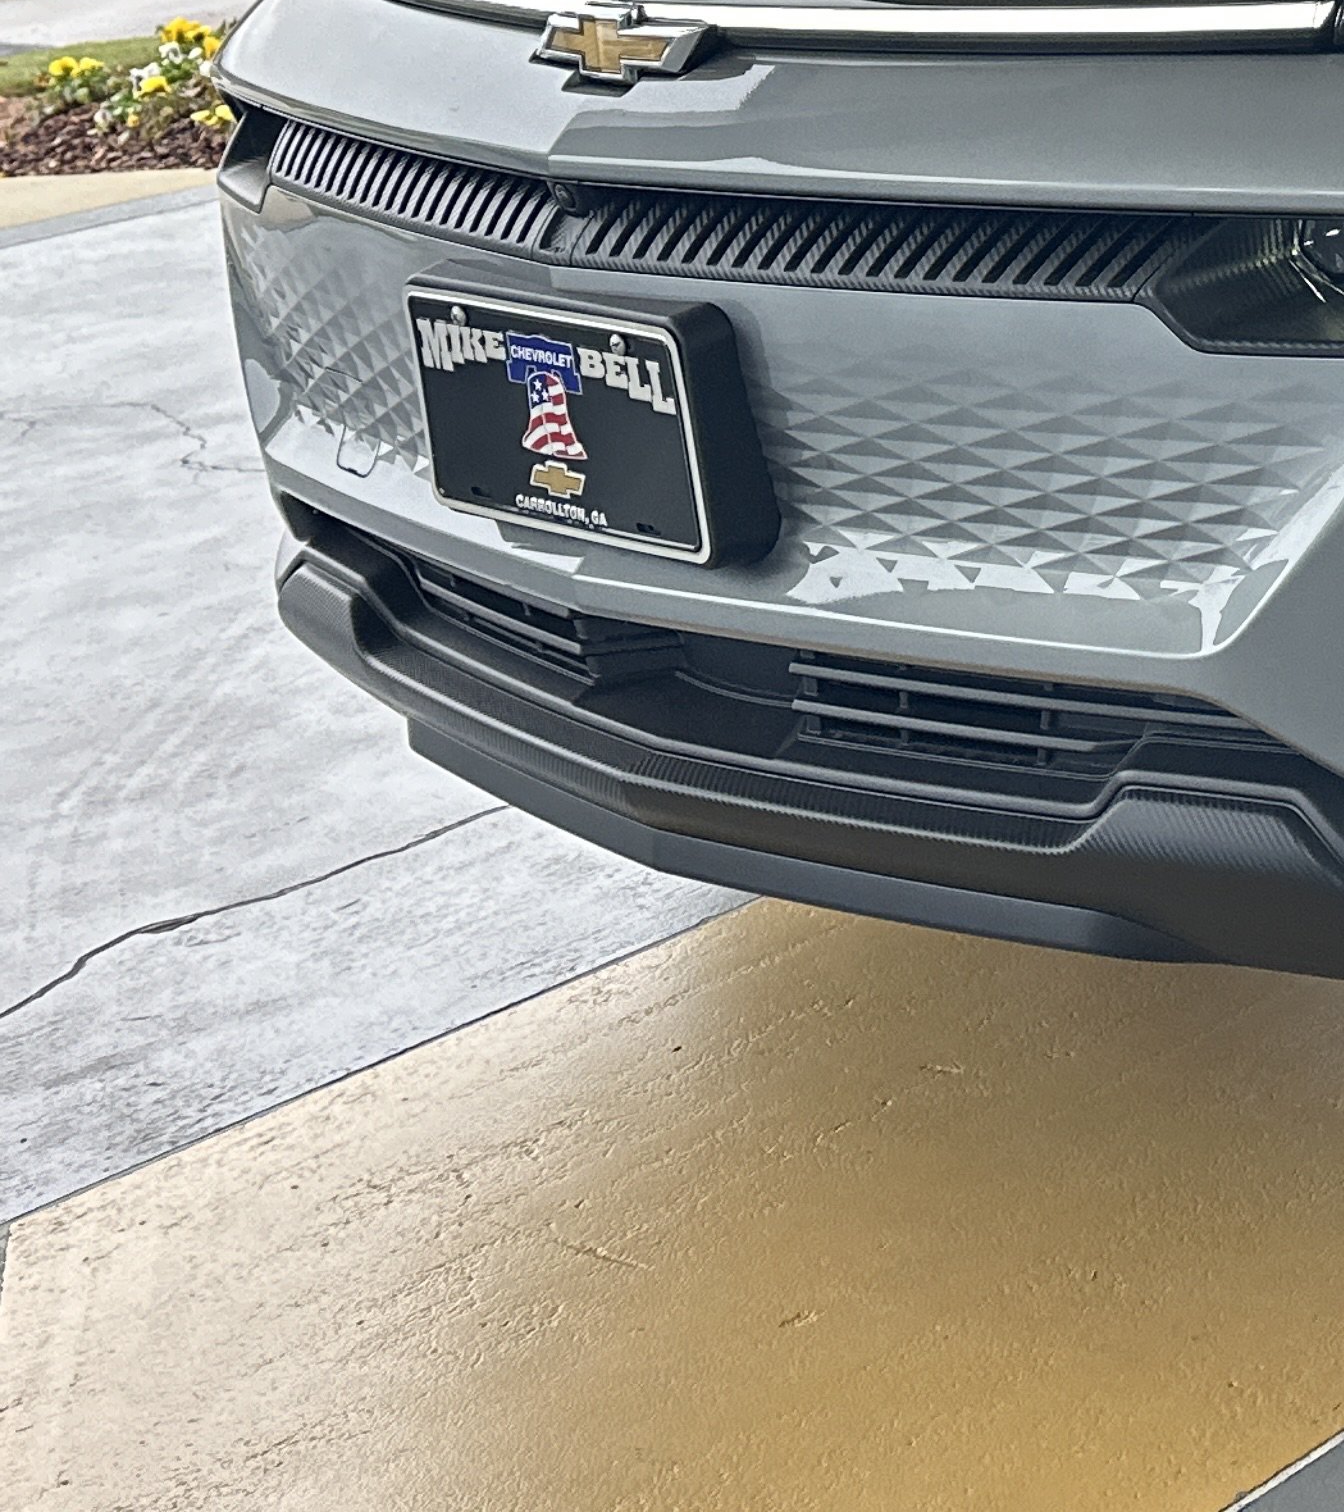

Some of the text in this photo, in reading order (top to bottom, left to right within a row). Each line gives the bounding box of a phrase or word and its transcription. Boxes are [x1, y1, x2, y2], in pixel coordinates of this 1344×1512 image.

[416, 317, 678, 416] MIKE BELL
[510, 343, 573, 369] CHEVROLET
[591, 509, 608, 527] GA
